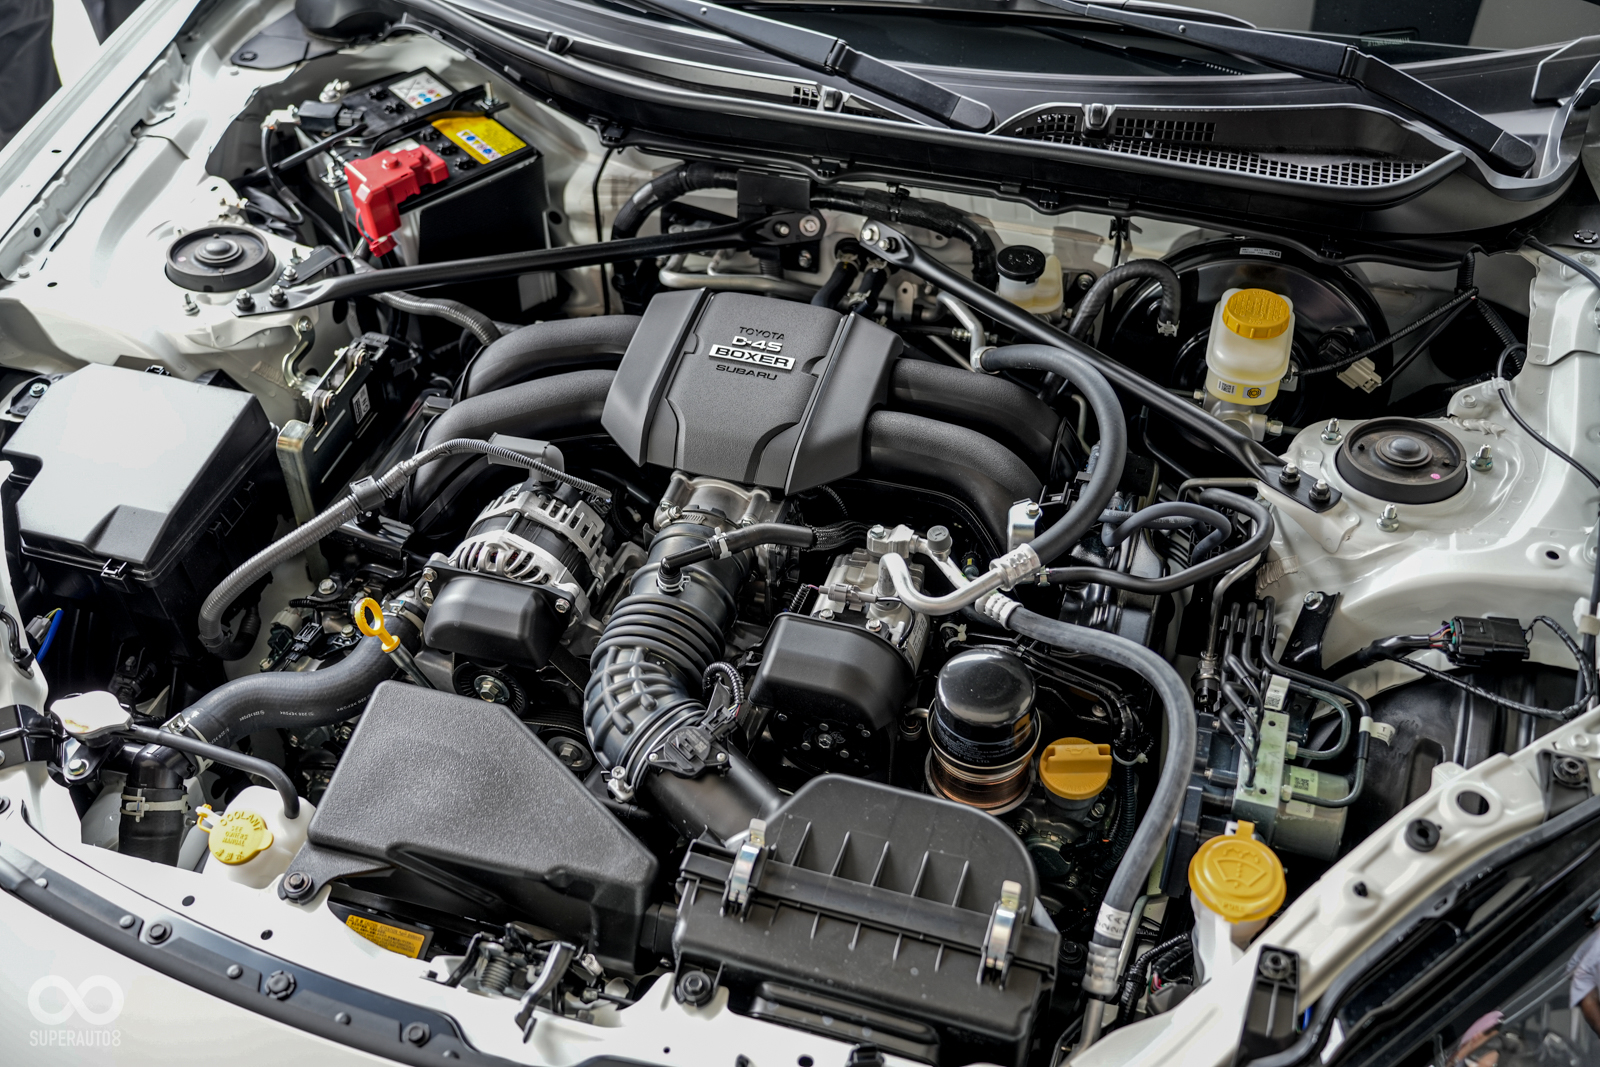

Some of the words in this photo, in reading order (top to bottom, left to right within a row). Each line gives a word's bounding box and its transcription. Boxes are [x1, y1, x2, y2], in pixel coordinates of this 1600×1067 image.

[739, 326, 785, 340] TOYOTA
[732, 335, 783, 352] D-4S
[715, 347, 790, 367] BOXER
[715, 364, 778, 381] SUBARU
[220, 811, 263, 831] COOLANT
